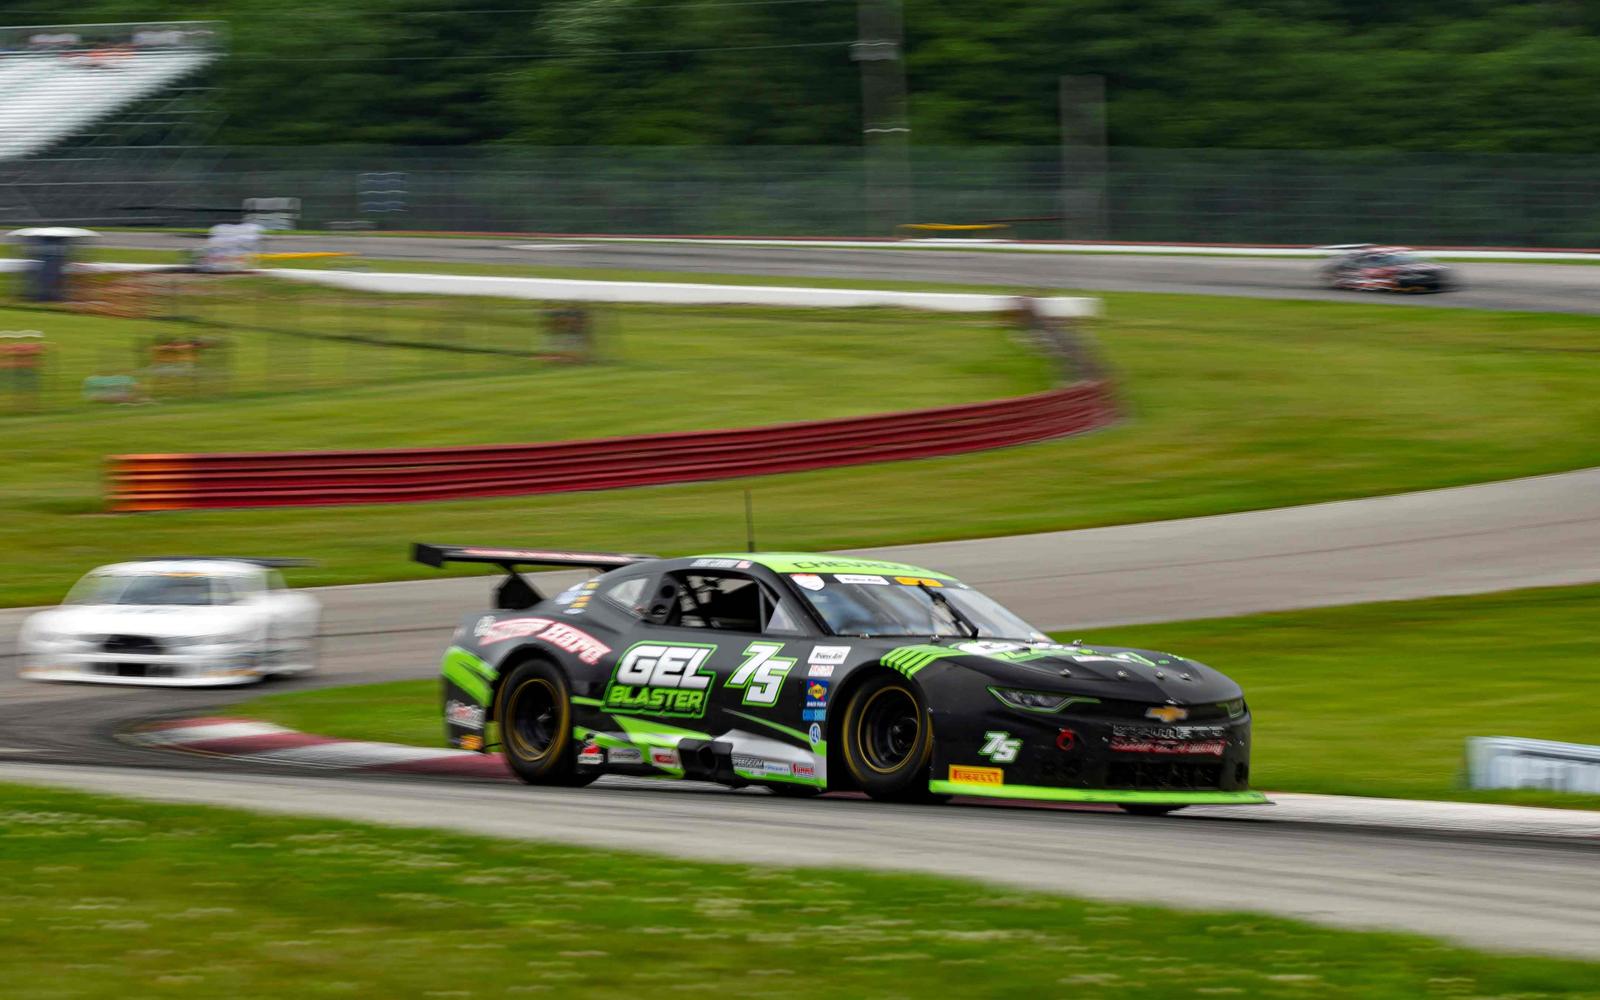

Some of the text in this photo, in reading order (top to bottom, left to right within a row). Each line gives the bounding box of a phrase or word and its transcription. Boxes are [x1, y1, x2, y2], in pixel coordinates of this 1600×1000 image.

[616, 644, 712, 690] GEL
[725, 641, 797, 707] 75
[609, 684, 705, 712] BLASTER
[978, 731, 1023, 763] 75
